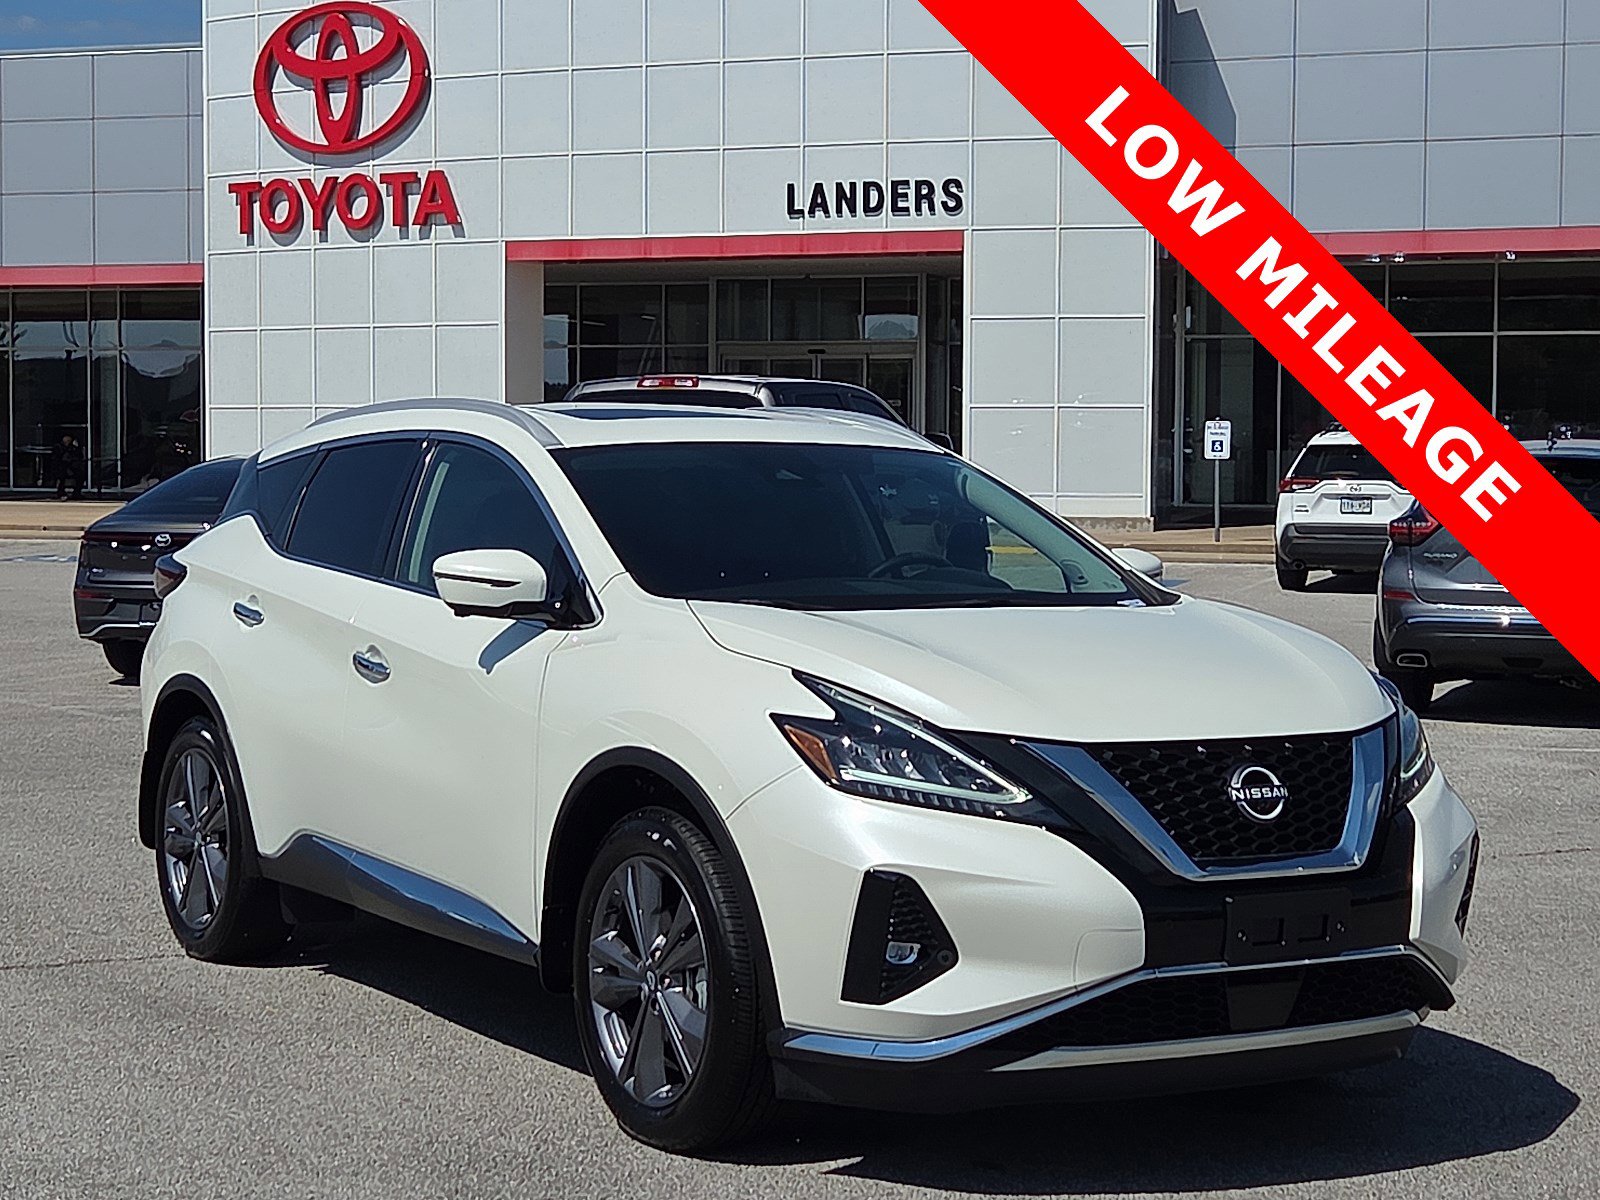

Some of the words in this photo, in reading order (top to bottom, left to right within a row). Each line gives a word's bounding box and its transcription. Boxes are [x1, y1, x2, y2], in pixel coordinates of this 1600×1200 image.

[228, 170, 463, 238] TOYOTA
[786, 178, 964, 219] LANDERS
[1228, 786, 1289, 801] NISSAN
